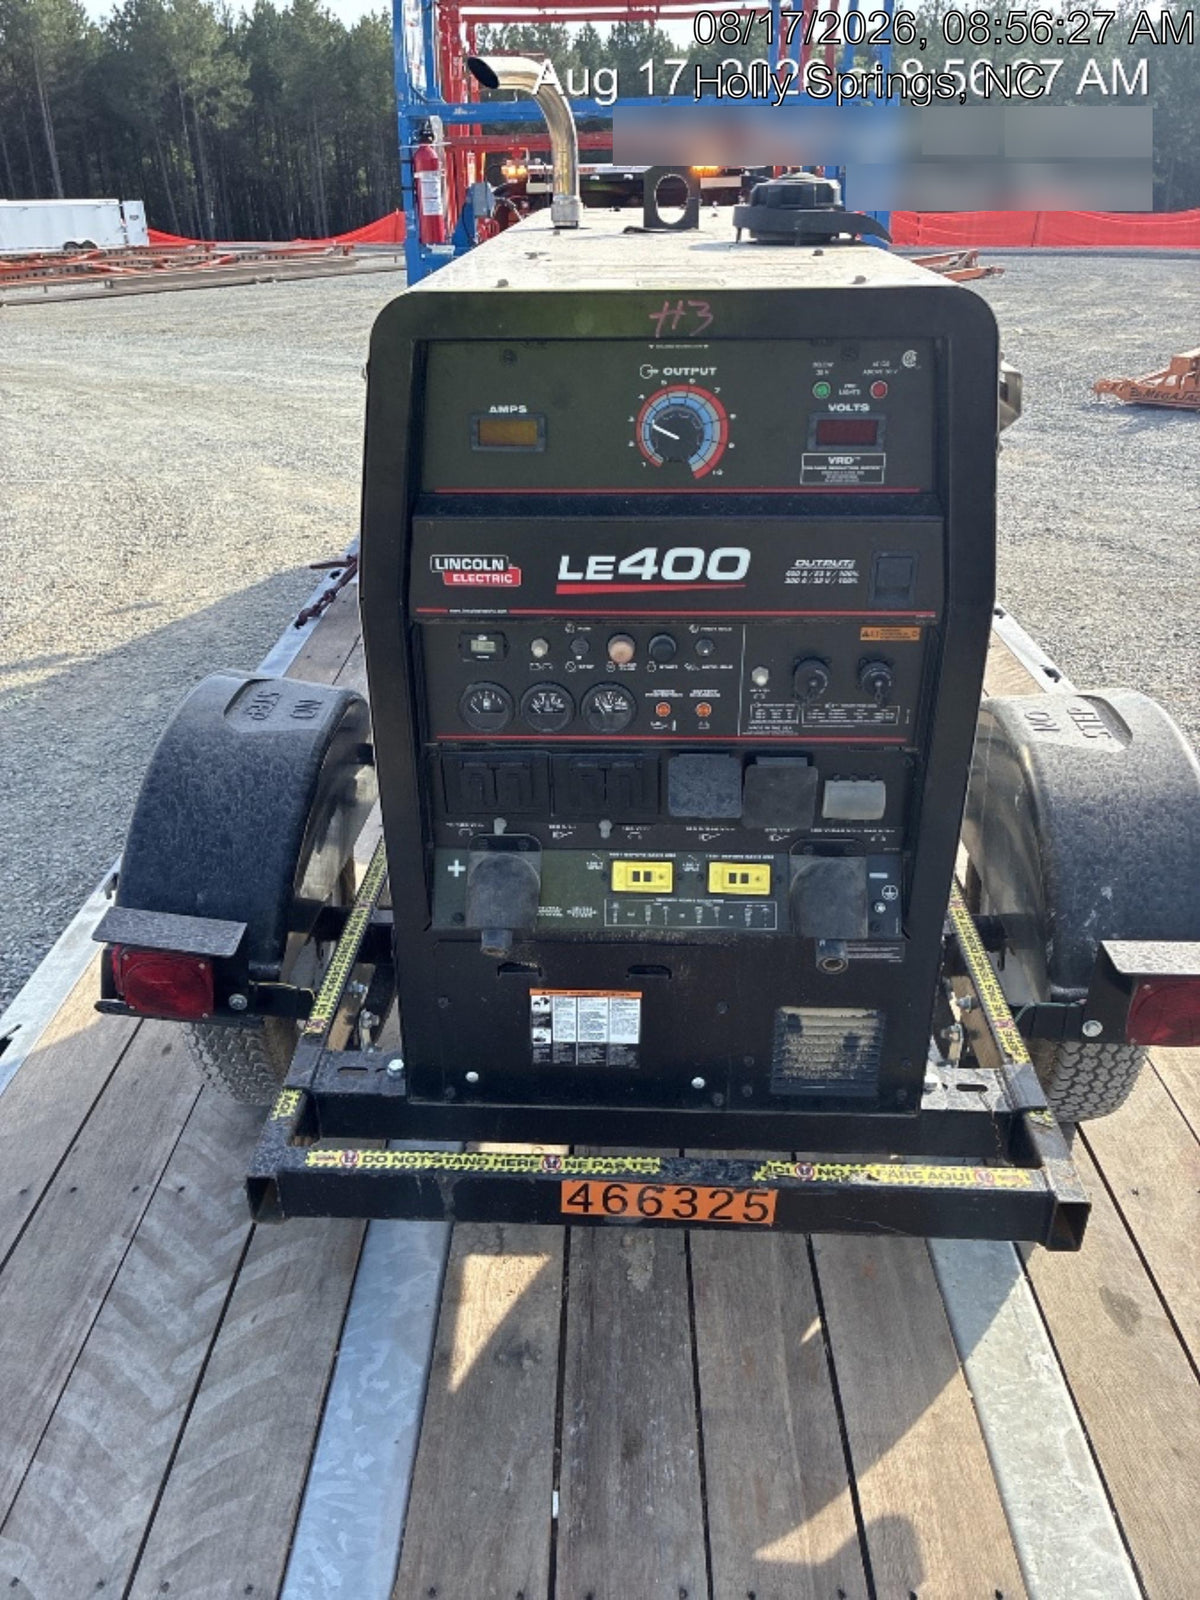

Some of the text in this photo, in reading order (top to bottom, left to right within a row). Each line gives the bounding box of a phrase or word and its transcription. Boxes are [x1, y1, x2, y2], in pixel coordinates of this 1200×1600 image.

[662, 367, 717, 376] OUTPUT
[488, 404, 528, 414] AMPS
[828, 402, 871, 412] VOLTS
[435, 557, 505, 571] LINCOLN
[557, 546, 752, 581] LE400
[452, 573, 513, 584] ELECTRIC
[362, 1155, 539, 1168] DO NOT STAND HERE
[591, 1161, 626, 1170] PAS
[817, 1168, 844, 1177] NO
[566, 1182, 770, 1223] 466325
